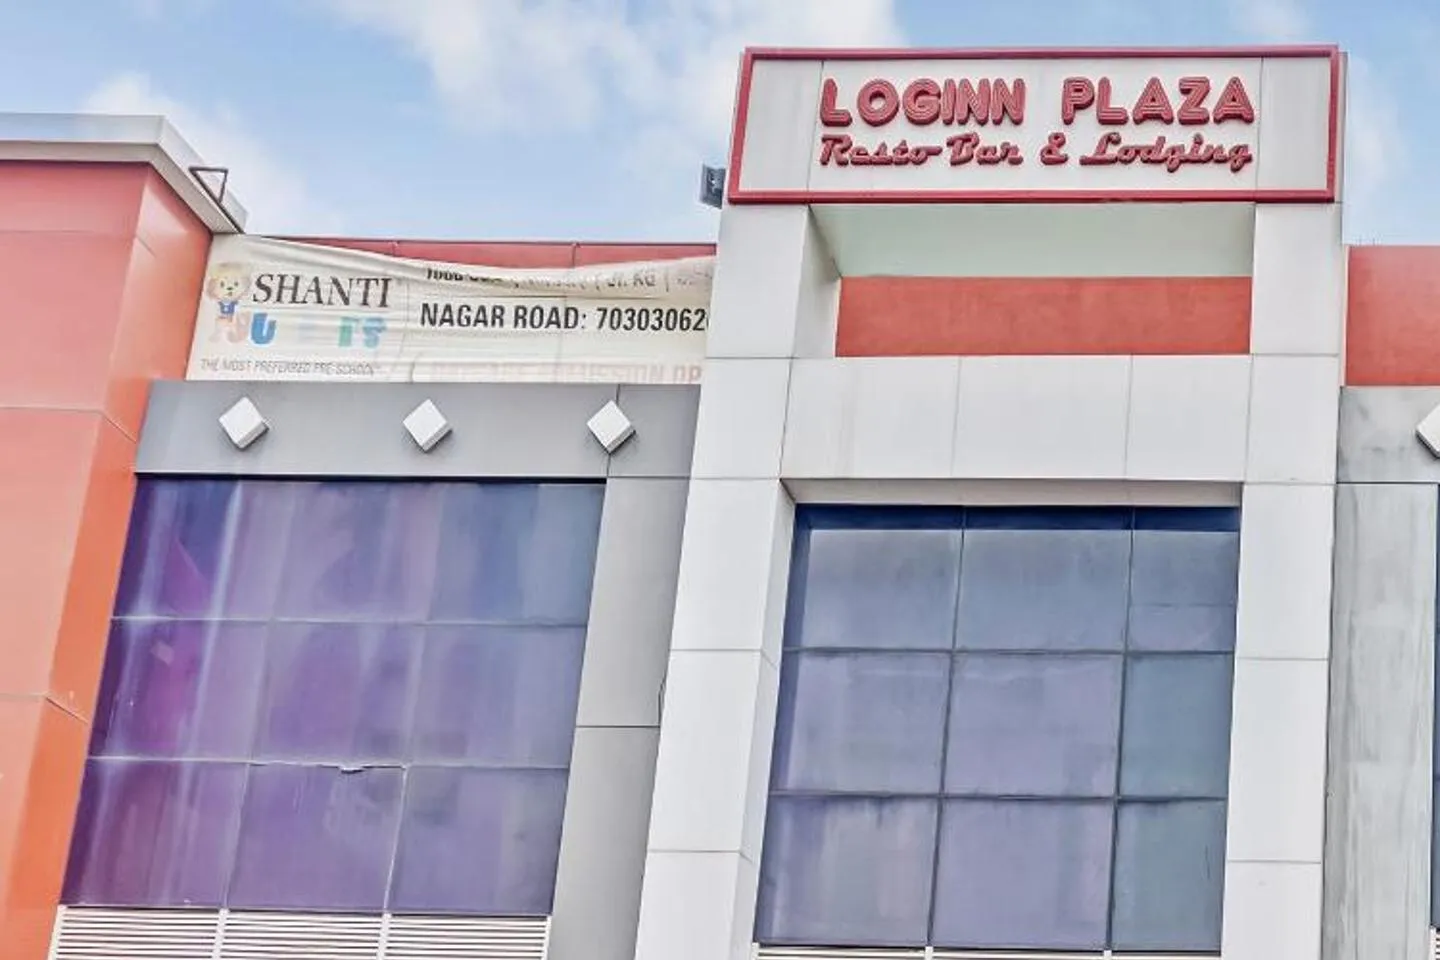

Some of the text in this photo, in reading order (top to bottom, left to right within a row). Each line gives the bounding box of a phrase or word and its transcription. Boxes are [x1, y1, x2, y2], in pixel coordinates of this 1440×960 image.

[820, 76, 1255, 126] LOGINN PLAZA
[819, 132, 1254, 173] Resto Bar & Lodging
[253, 273, 393, 309] SHANTI
[420, 303, 709, 332] NAGAR ROAD: 70303062
[222, 359, 251, 373] MOST
